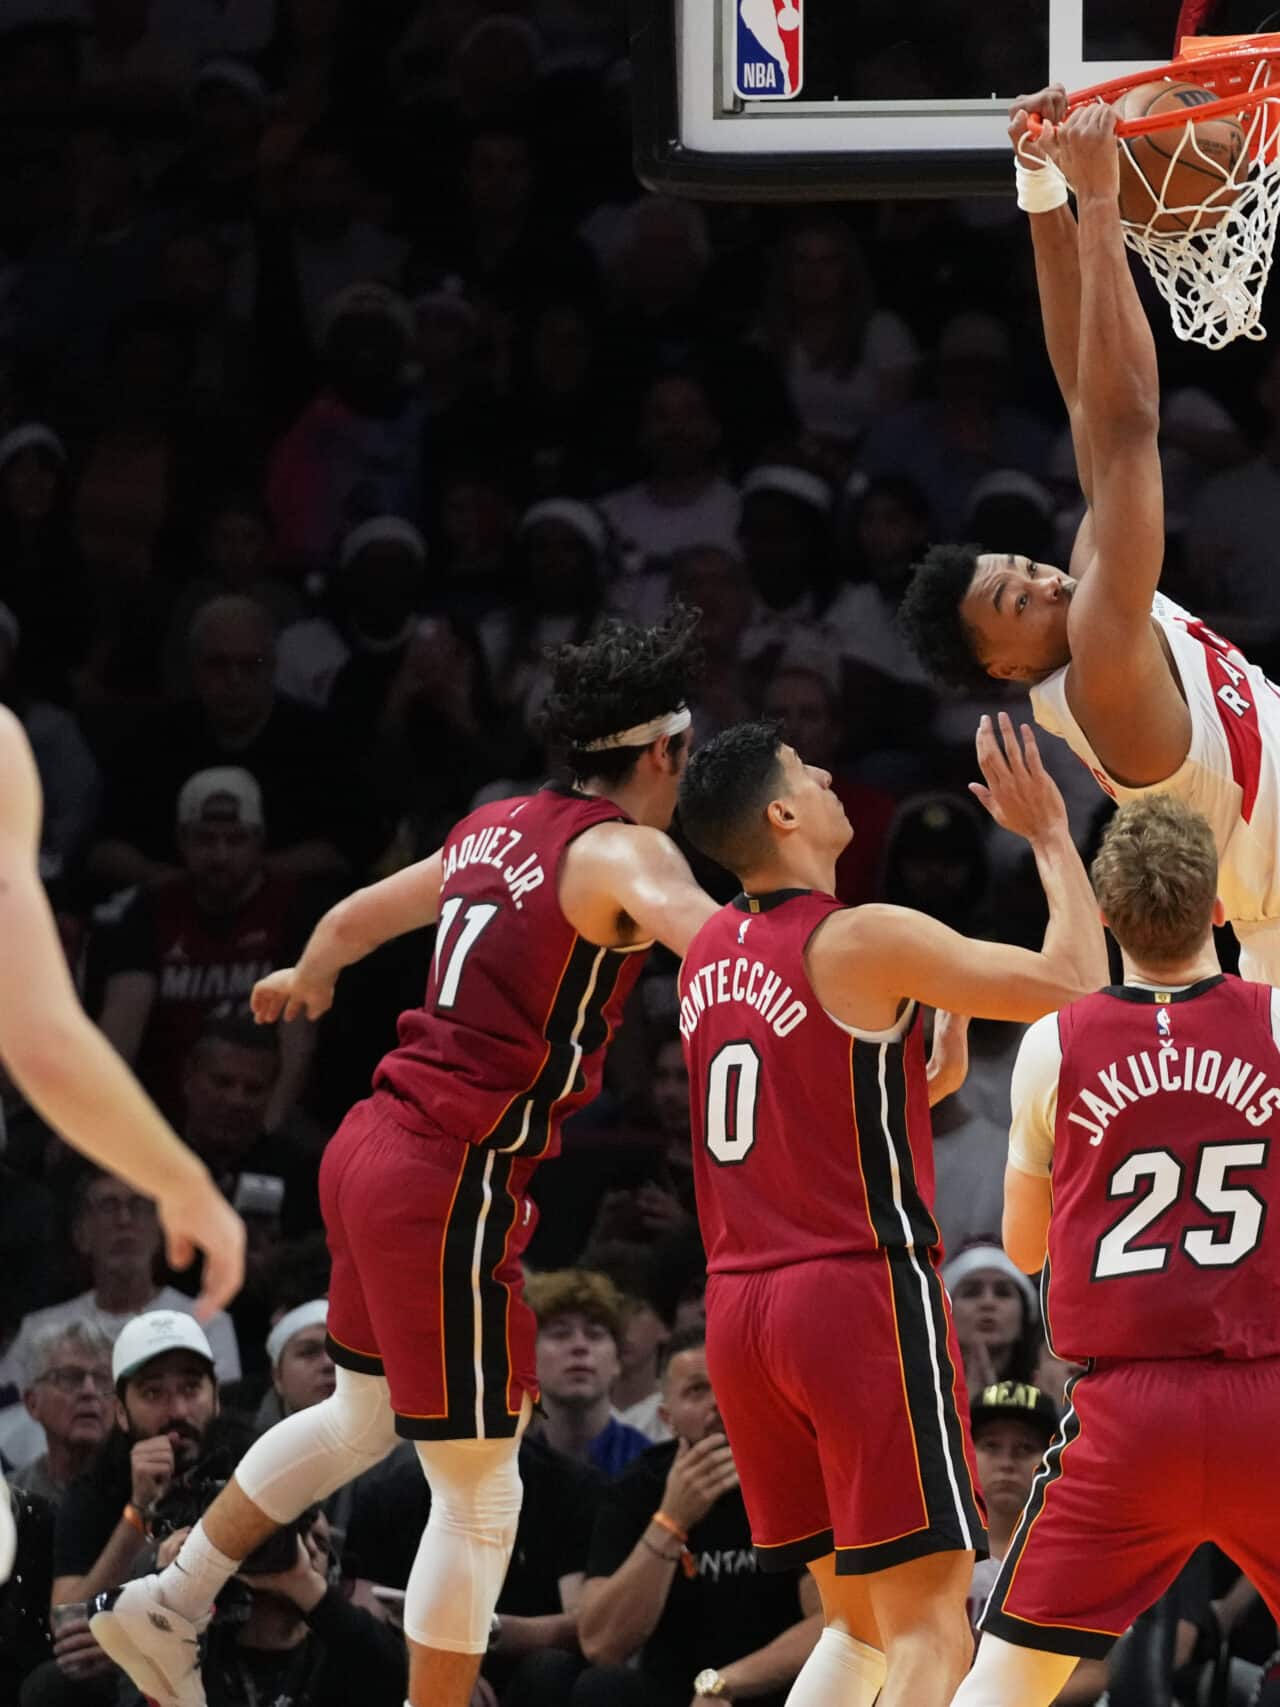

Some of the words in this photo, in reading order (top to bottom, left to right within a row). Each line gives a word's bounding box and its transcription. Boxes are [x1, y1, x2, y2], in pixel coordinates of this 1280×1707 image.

[743, 62, 777, 89] NBA
[503, 852, 545, 911] JR.
[434, 896, 499, 1008] 11
[707, 1041, 761, 1167] 0
[1091, 1139, 1270, 1281] 25
[982, 1380, 1041, 1410] HEAT
